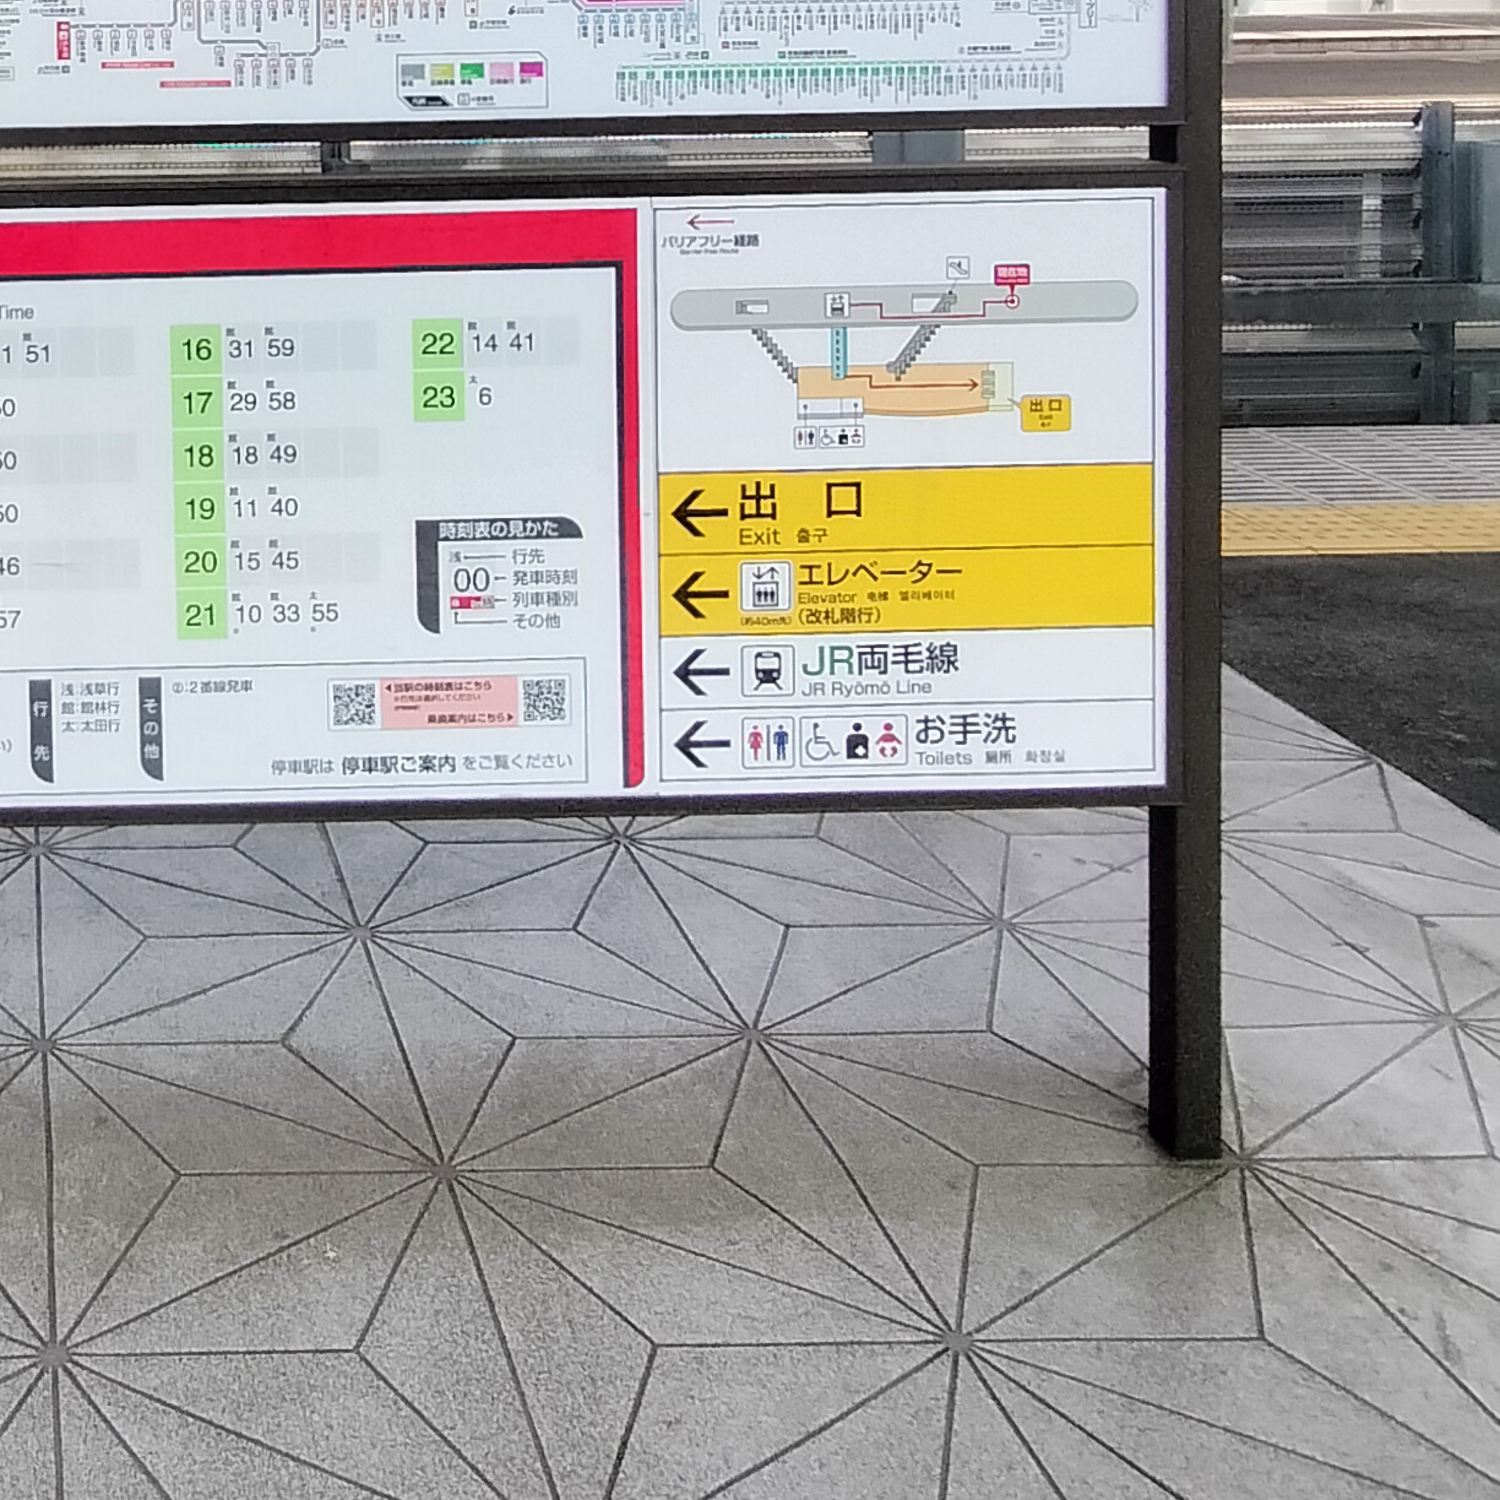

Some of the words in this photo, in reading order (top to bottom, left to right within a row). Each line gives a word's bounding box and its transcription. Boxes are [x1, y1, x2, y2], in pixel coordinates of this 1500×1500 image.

[661, 234, 760, 248] バリアフリー経路
[26, 345, 49, 363] 51
[183, 339, 211, 360] 16
[229, 340, 252, 358] 31
[268, 339, 294, 357] 59
[422, 333, 454, 354] 22
[473, 334, 497, 352] 14
[510, 333, 532, 351] 41
[184, 392, 213, 414] 17
[230, 393, 256, 411] 29
[269, 392, 295, 410] 58
[423, 386, 455, 408] 23
[479, 387, 492, 405] 6
[1030, 399, 1062, 412] 出口
[185, 445, 213, 467] 18
[233, 446, 258, 464] 18
[270, 445, 296, 463] 49
[186, 498, 214, 520] 19
[234, 500, 255, 517] 11
[271, 498, 298, 516] 40
[740, 481, 861, 521] 出口
[439, 521, 559, 539] 時刻表の見かた
[739, 528, 781, 545] Exit
[797, 528, 828, 543] 출구
[185, 551, 217, 573] 20
[235, 552, 260, 570] 15
[272, 551, 298, 569] 45
[512, 548, 545, 564] 行先
[454, 568, 490, 592] 00
[512, 569, 578, 586] 発車時刻
[798, 560, 962, 586] エレベーター
[512, 591, 578, 608] 列車種別
[797, 590, 858, 605] Elevator
[186, 604, 213, 626] 21
[236, 605, 261, 623] 10
[273, 604, 300, 623] 33
[312, 603, 338, 622] 55
[512, 613, 561, 629] その他
[799, 606, 880, 625] （改札階行）
[803, 642, 959, 676] JR両毛線
[802, 682, 825, 696] JR
[897, 680, 931, 694] Line
[33, 701, 50, 762] 行先
[61, 719, 121, 733] 太：太田行
[142, 698, 160, 759] その他
[916, 713, 1016, 745] お手洗
[271, 759, 335, 775] 停車駅は
[341, 754, 456, 775] 停車駅ご案内
[462, 753, 573, 772] をご覧ください
[915, 751, 972, 765] Toilets
[1026, 750, 1065, 763] 화장실
